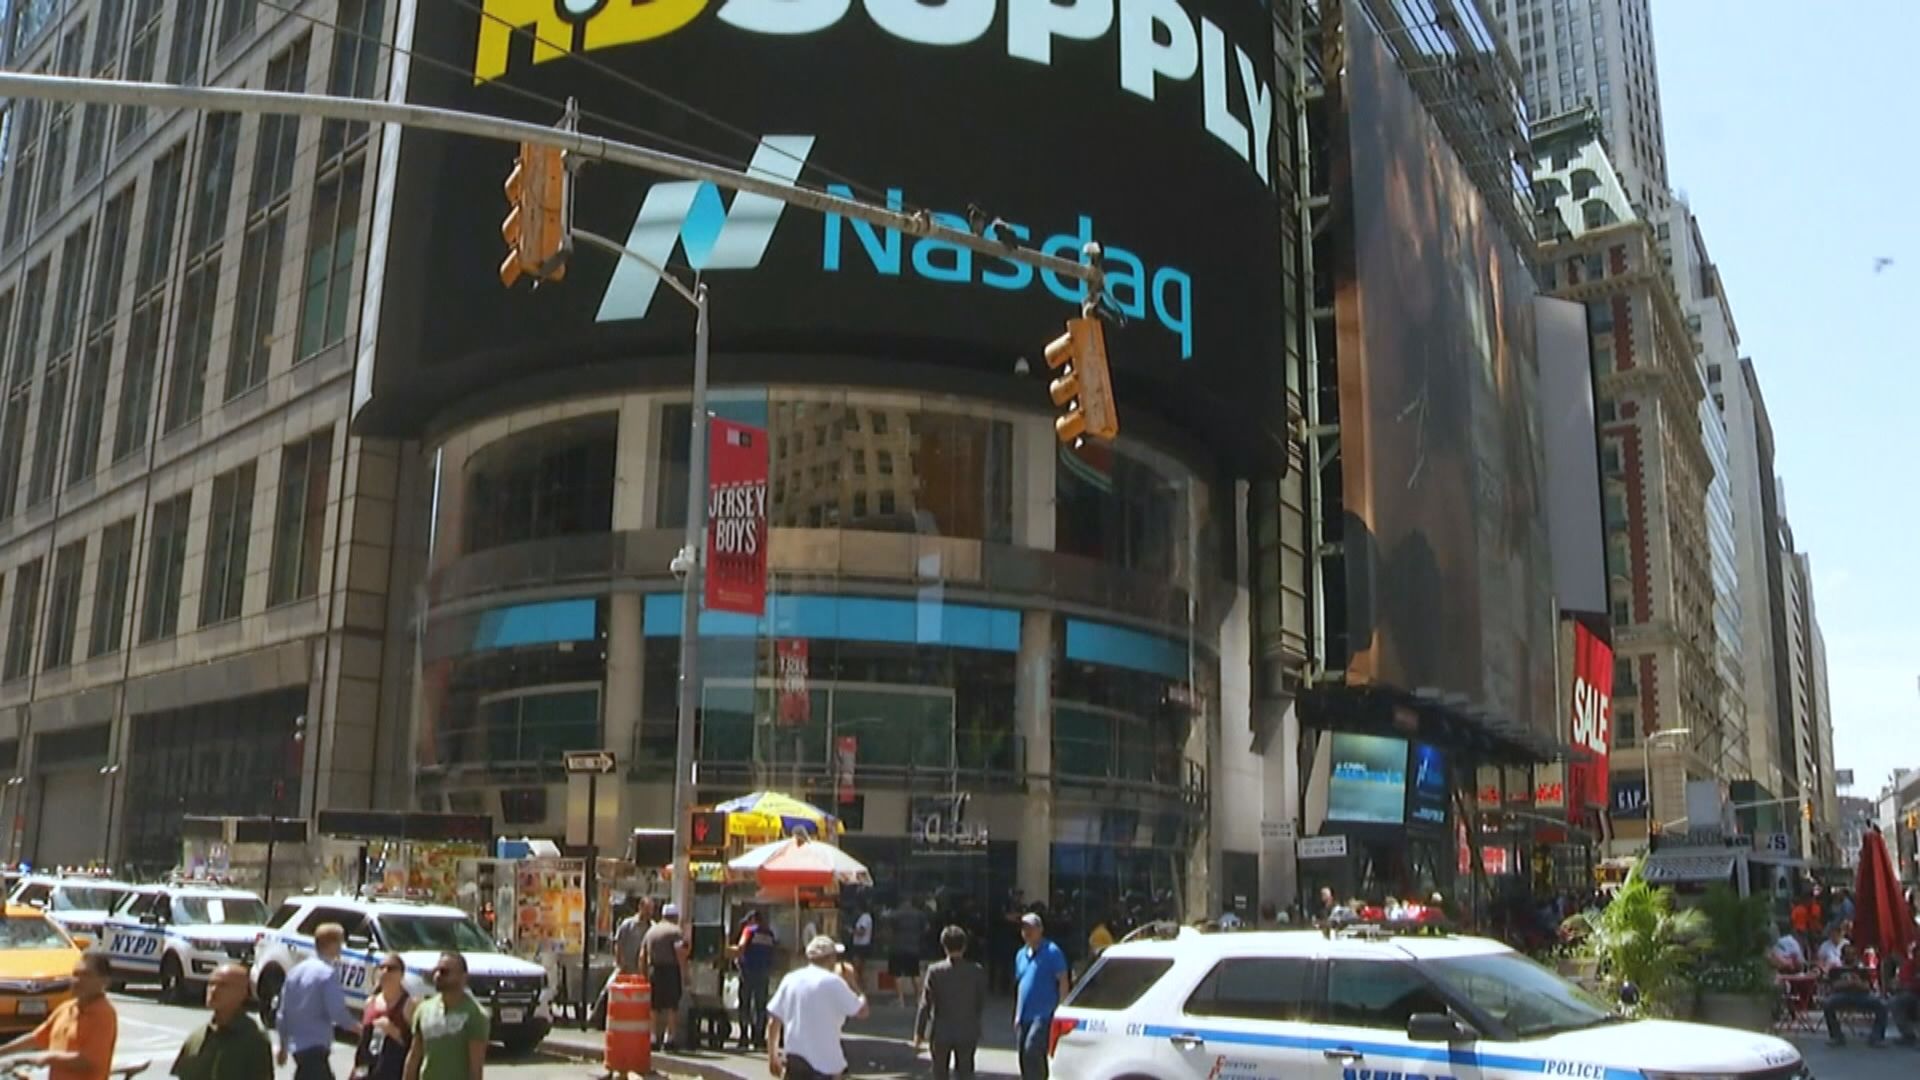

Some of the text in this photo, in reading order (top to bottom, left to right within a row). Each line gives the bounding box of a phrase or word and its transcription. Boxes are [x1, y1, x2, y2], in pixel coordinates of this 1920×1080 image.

[822, 183, 1193, 360] Nasdaq
[708, 483, 767, 520] JERSEY
[716, 518, 758, 554] BOYS
[1573, 676, 1608, 756] SALE
[1617, 789, 1641, 810] GAP
[110, 933, 158, 956] NYPD
[1547, 1060, 1603, 1080] POLICE
